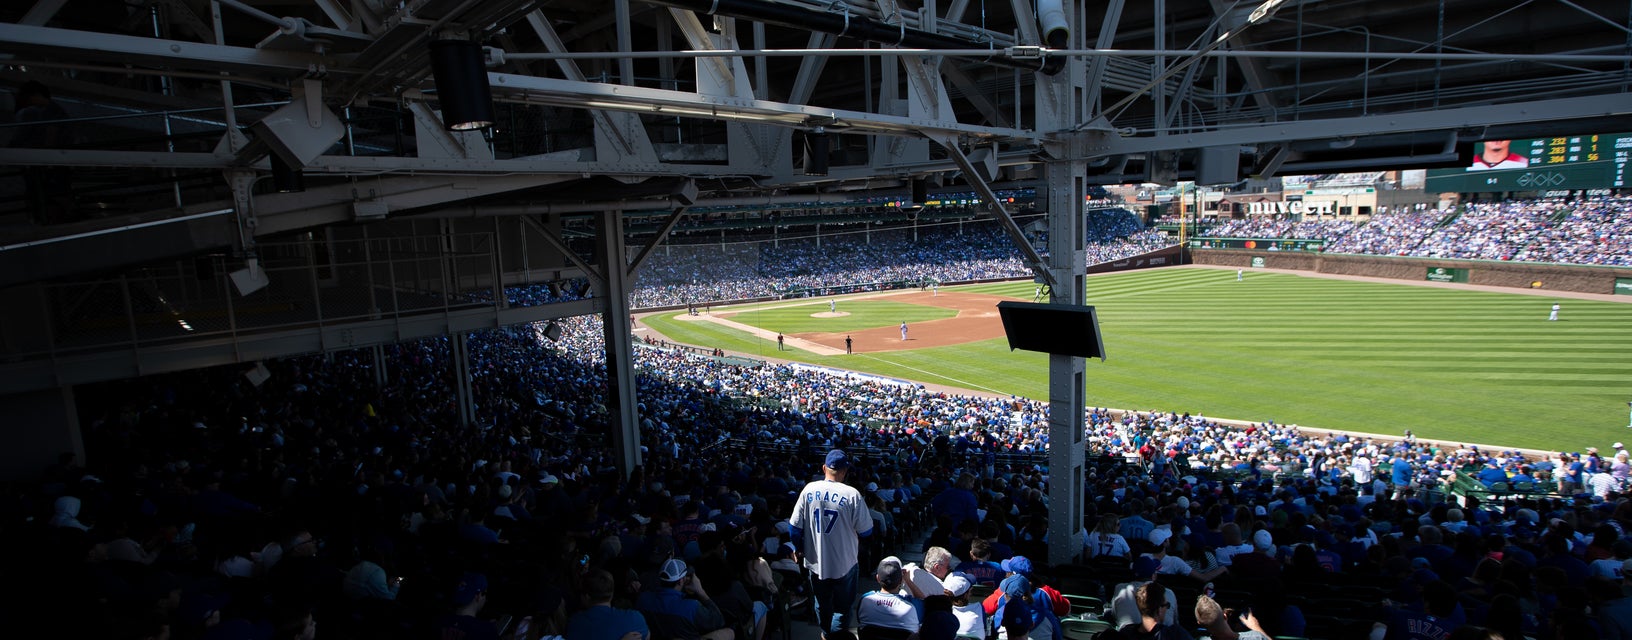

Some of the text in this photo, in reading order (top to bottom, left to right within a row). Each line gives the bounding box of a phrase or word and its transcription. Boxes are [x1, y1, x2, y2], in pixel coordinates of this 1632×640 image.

[1249, 201, 1334, 214] nuveen
[807, 491, 847, 506] GRACE
[813, 508, 839, 533] 17
